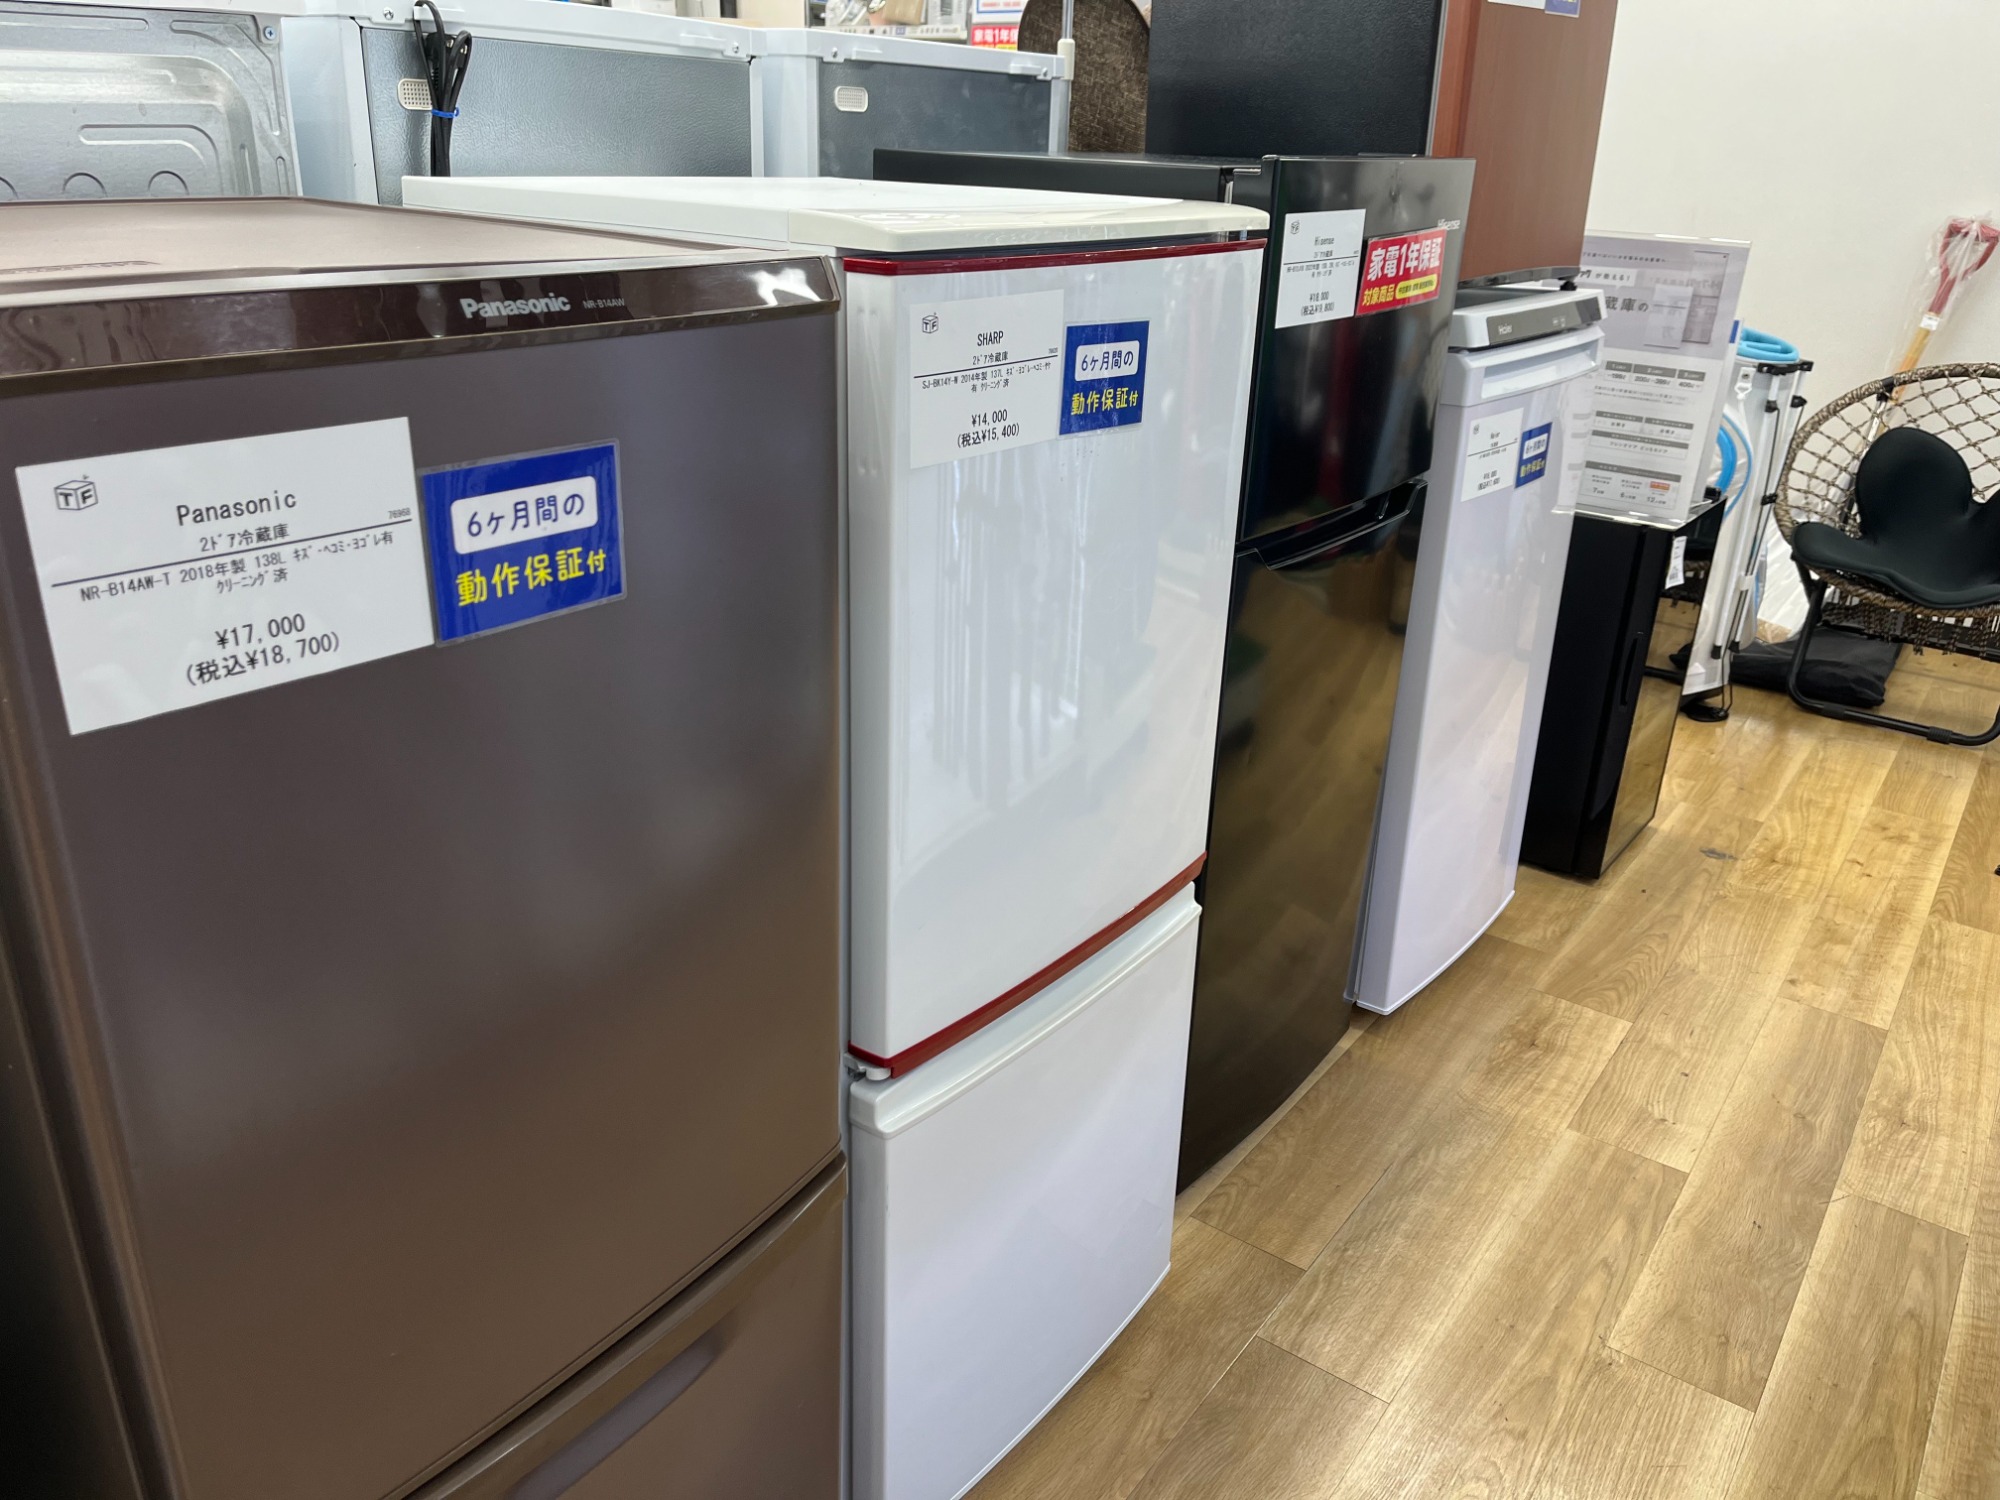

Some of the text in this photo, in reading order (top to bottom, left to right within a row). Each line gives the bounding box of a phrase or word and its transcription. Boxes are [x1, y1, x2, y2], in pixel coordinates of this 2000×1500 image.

[1367, 237, 1442, 281] 家電1年保証
[459, 292, 626, 318] Panasonic NR-B14AW
[1362, 284, 1396, 306] 対象商品
[977, 330, 1004, 347] SHARP
[1080, 349, 1134, 372] 6ヶ月間の
[960, 371, 988, 384] 2014年製
[990, 369, 1004, 380] 137L
[1071, 387, 1138, 416] 動作保証付
[971, 408, 1008, 427] ¥14,000
[957, 423, 1020, 448] (税込¥15,400)
[176, 490, 297, 526] Panasonic
[466, 493, 585, 537] 6ヶ月間の
[79, 571, 172, 602] NR-B14AW-T
[180, 557, 246, 584] 2018年製
[254, 552, 287, 569] 138L
[455, 547, 606, 607] 動作保証付
[214, 613, 306, 650] ¥17,000
[186, 631, 341, 687] (税込¥18,700)
